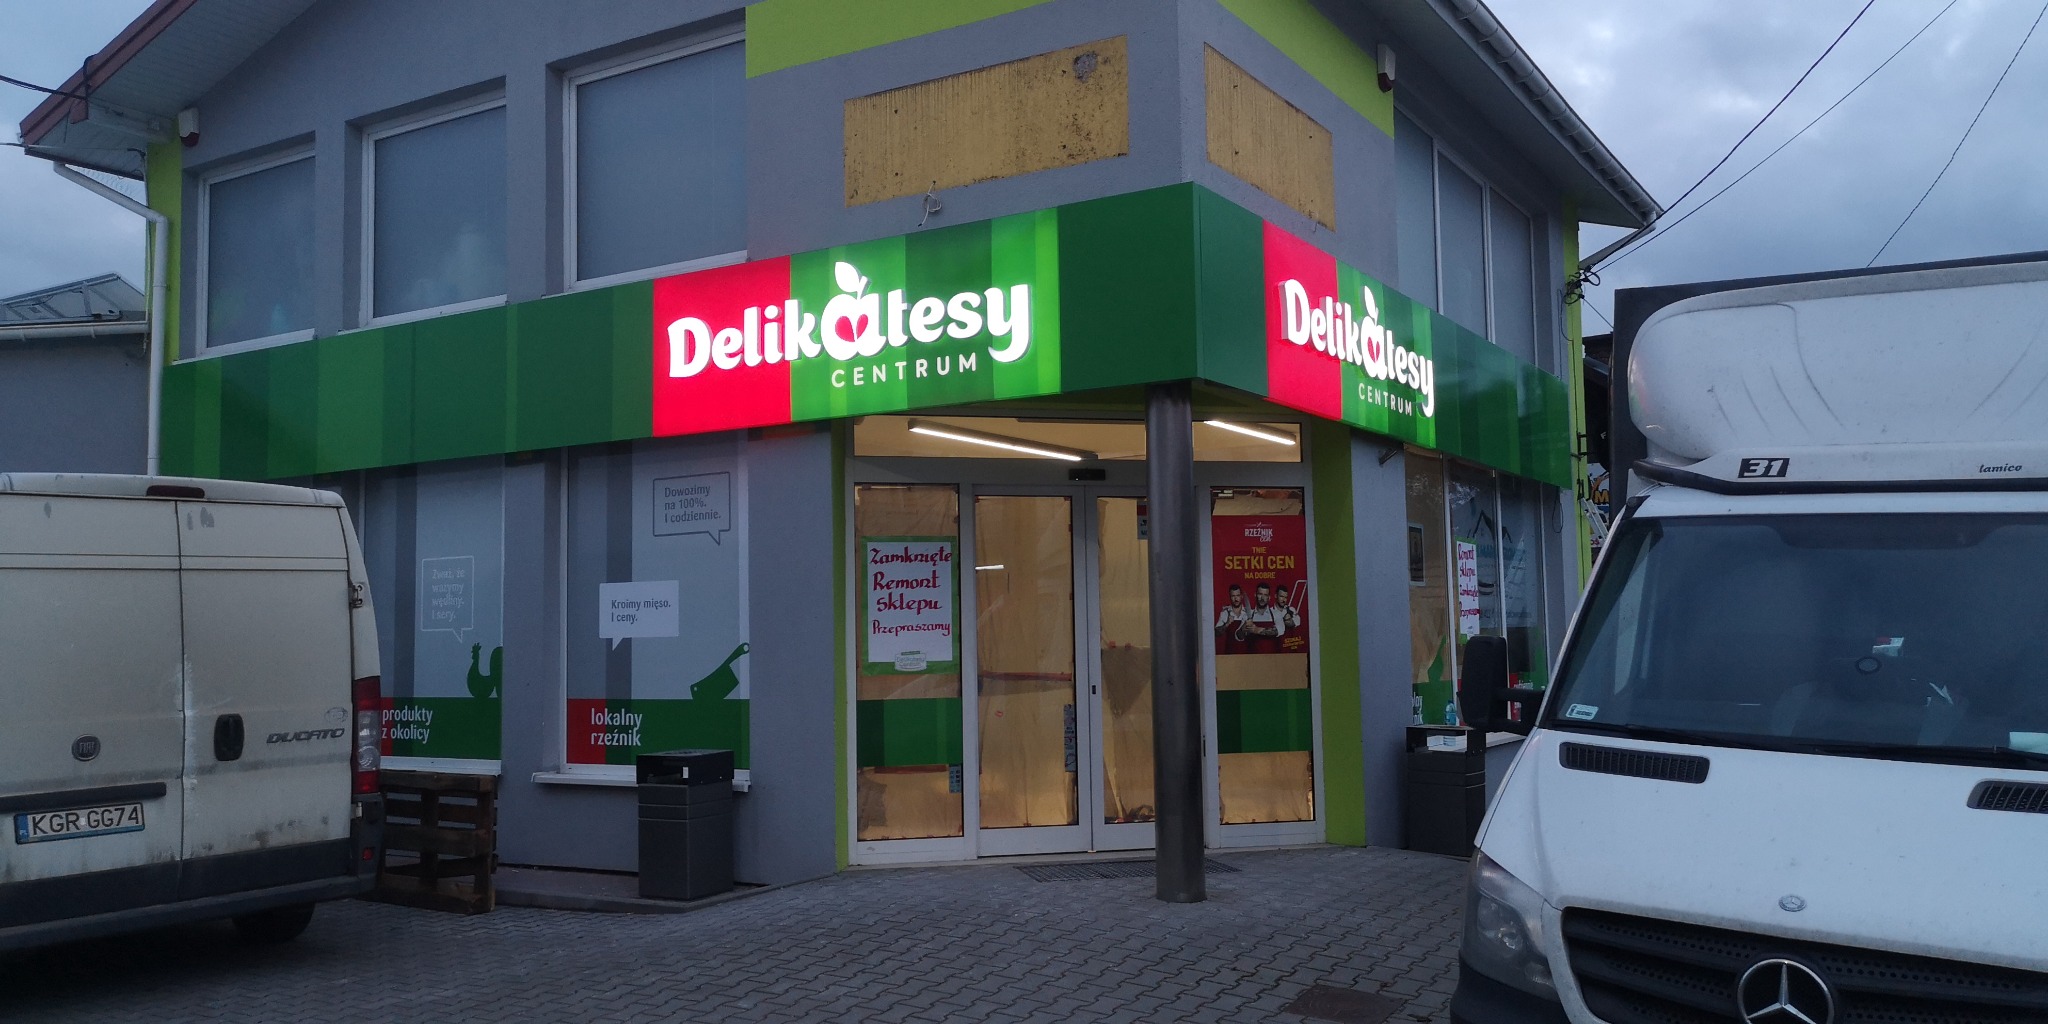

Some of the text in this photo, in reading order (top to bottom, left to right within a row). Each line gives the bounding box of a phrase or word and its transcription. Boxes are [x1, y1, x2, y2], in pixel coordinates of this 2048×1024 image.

[667, 280, 1033, 378] Delikatesy
[1279, 279, 1435, 417] Delikatesy
[831, 352, 977, 388] CENTRUM
[1358, 382, 1412, 416] CENTRUM
[1742, 459, 1784, 477] 31
[664, 485, 711, 498] Dowozimy
[664, 501, 676, 511] na
[670, 509, 721, 523] codziennie.
[869, 545, 953, 566] Zamknięte
[1224, 555, 1295, 570] SETKI CEN
[873, 569, 941, 591] Remont
[1244, 571, 1276, 580] NA DOBRE
[611, 598, 671, 611] Kroimy mięso.
[616, 613, 638, 624] ceny.
[872, 620, 951, 637] Przepraszamy
[382, 705, 433, 726] produkty
[591, 708, 643, 730] lokalny
[266, 727, 345, 744] DUCATO
[381, 724, 430, 744] z okolicy
[591, 728, 641, 746] rzeźnik
[80, 741, 95, 754] FIAT
[32, 806, 139, 835] KGR GG74
